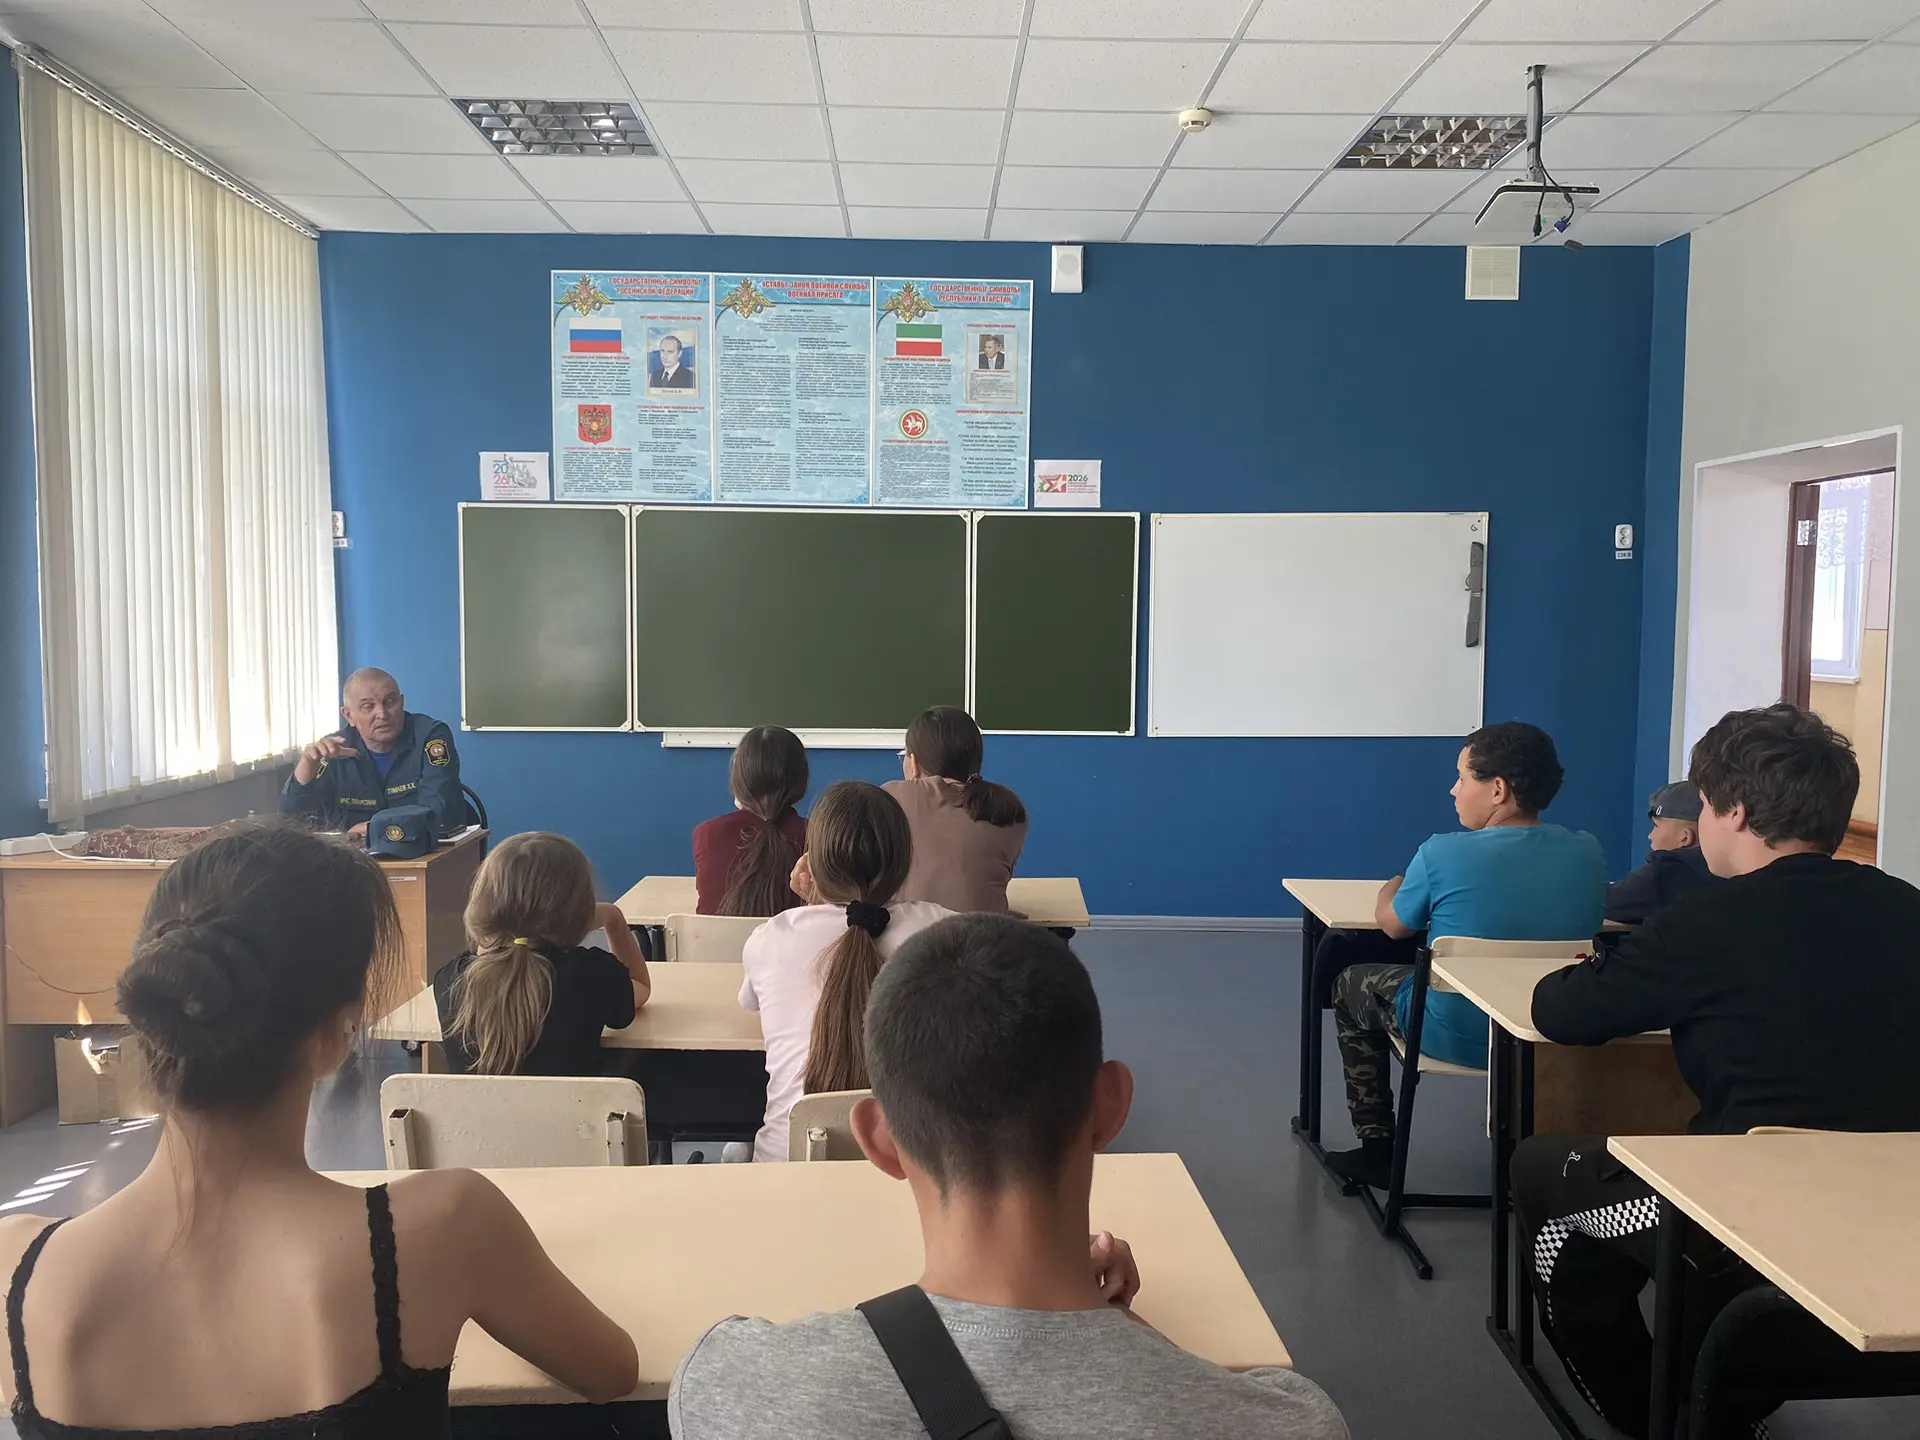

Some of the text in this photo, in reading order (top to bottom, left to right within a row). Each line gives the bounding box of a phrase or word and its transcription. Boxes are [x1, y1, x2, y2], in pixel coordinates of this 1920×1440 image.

[670, 278, 701, 286] СИМВОЛЫ
[989, 286, 1020, 294] СИМВОЛЫ
[816, 291, 844, 299] ПРИСЯГА
[978, 295, 1011, 303] ТАТАРСТАН
[493, 463, 508, 474] 20
[1068, 474, 1088, 482] 2026
